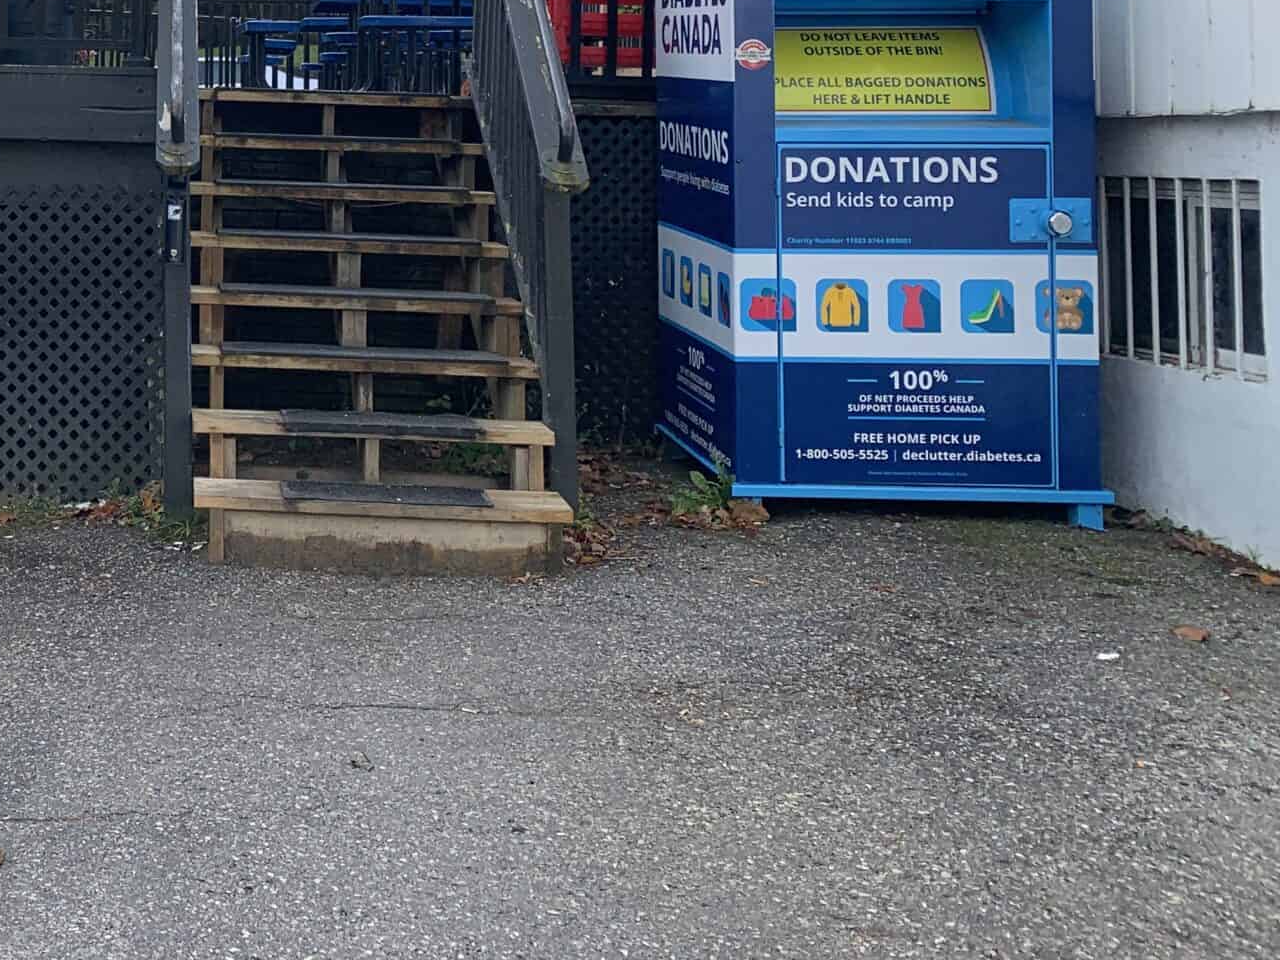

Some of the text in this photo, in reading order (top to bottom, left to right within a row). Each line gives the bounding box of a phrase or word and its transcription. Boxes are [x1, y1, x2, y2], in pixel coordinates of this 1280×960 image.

[661, 13, 722, 55] CANADA
[799, 32, 940, 42] DO NOT LEAVE ITEMS
[804, 46, 944, 56] OUTSIDE OF THE BIN!
[775, 76, 986, 88] PLACE ALL BAGGED DONATIONS
[813, 94, 951, 105] HERE & LIFT HANDLE
[660, 120, 729, 165] DONATIONS
[785, 156, 999, 184] DONATIONS
[786, 192, 954, 212] Send kids to camp
[888, 369, 949, 390] 100%
[859, 394, 975, 404] OF NET PROCEEDS HELP
[847, 404, 986, 414] SUPPORT DIABETES CANADA
[853, 432, 982, 445] FREE HOME PICK UP
[795, 448, 1041, 463] 1-800-505-5525 declutter.diabetes.ca
